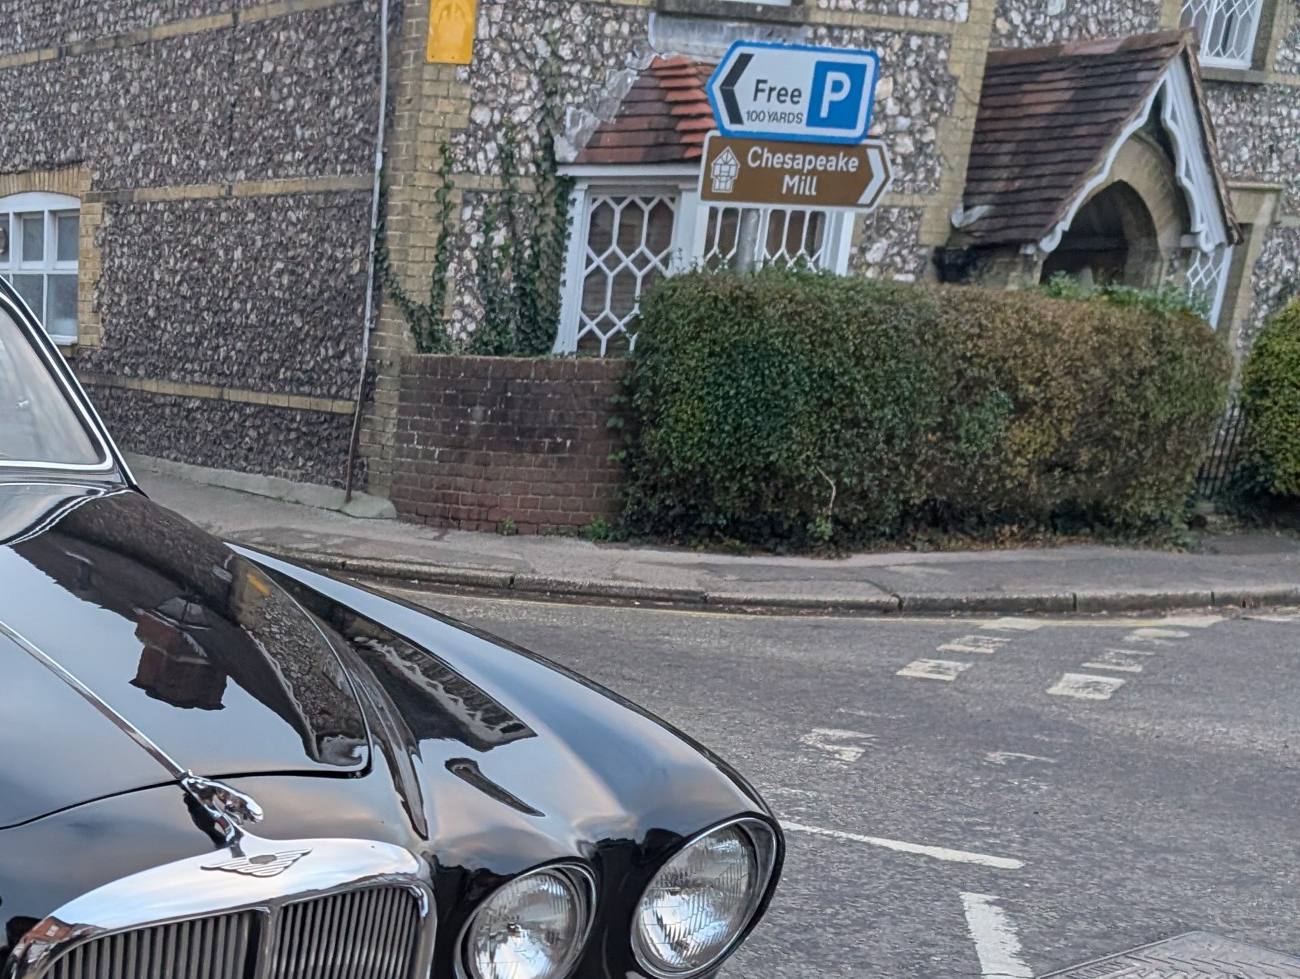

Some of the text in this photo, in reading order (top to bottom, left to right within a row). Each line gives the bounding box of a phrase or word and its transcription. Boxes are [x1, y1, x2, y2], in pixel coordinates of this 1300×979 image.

[753, 78, 803, 105] Free
[820, 71, 852, 118] P
[746, 109, 804, 125] 100 YARDS
[747, 145, 859, 174] Chesapeake
[781, 174, 818, 196] Mill
